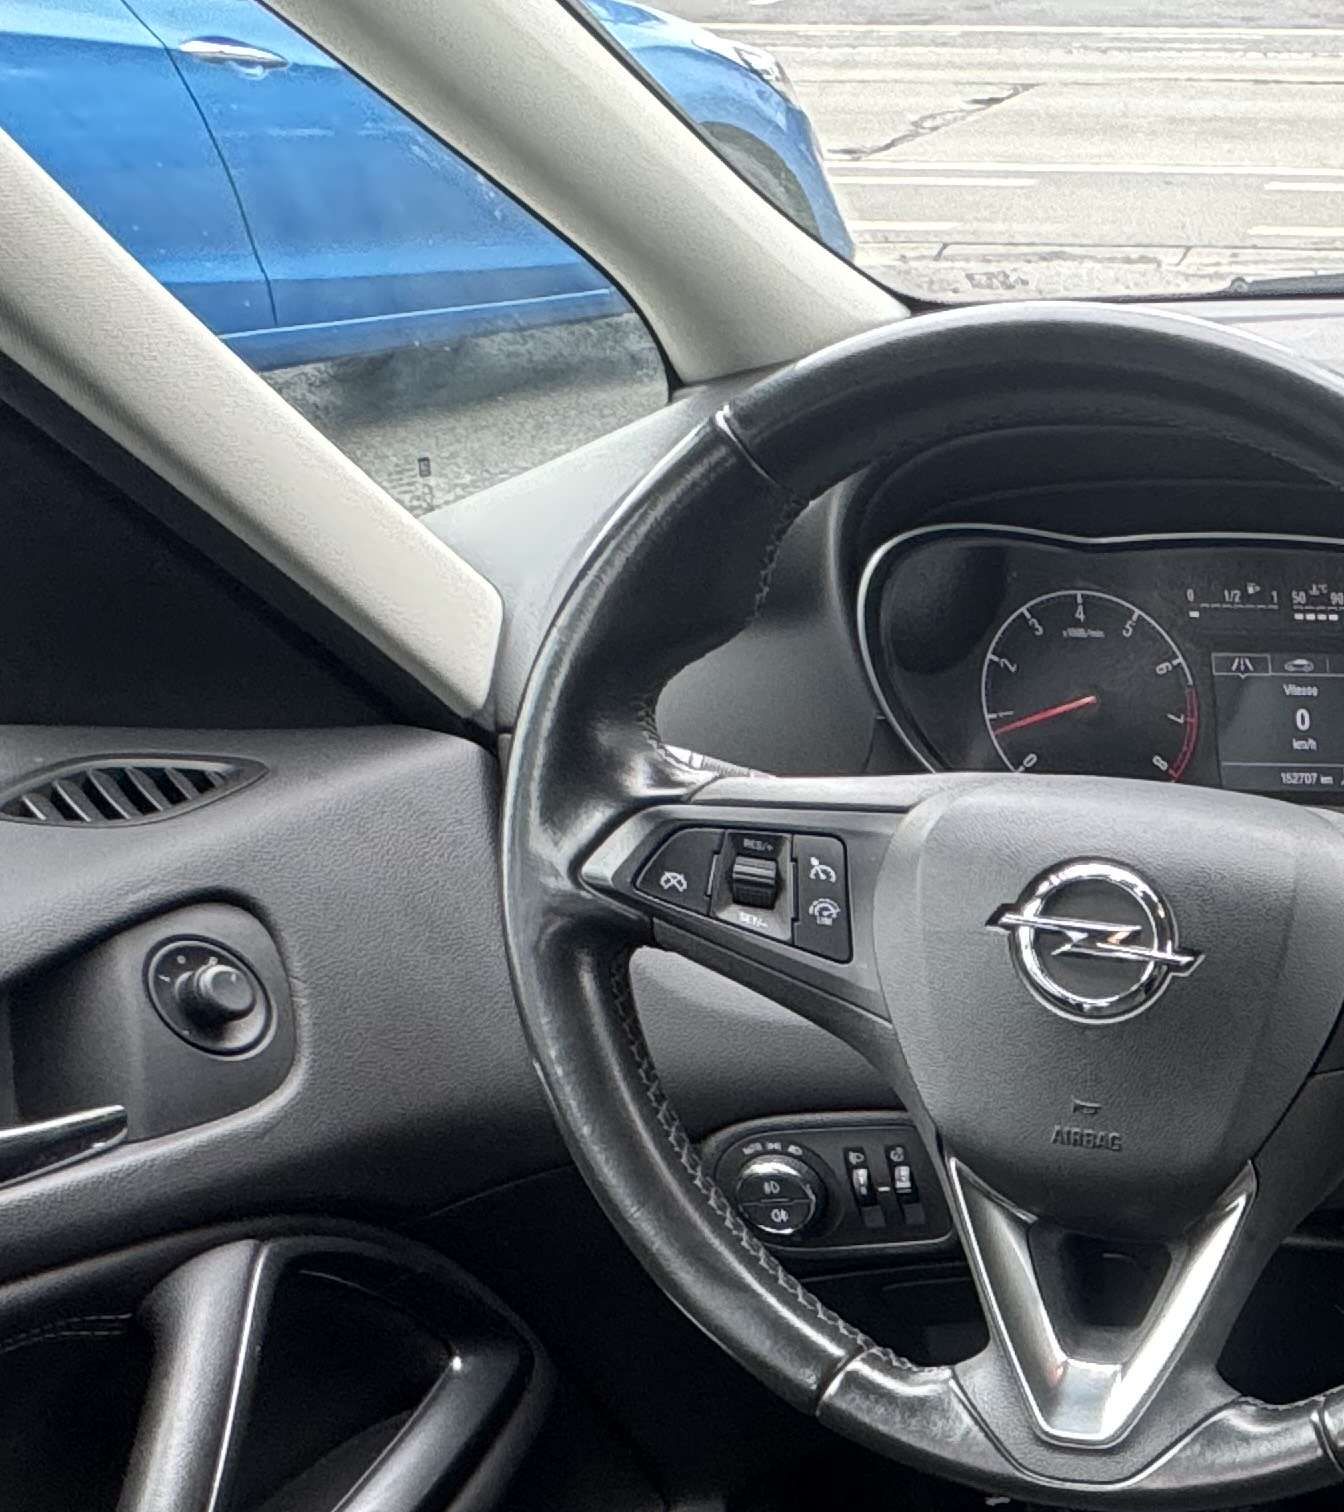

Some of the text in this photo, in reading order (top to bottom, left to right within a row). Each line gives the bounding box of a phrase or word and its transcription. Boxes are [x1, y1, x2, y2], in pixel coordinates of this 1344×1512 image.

[1075, 604, 1085, 622] 4
[1028, 618, 1044, 636] 3
[1122, 620, 1135, 637] 5
[1000, 657, 1017, 673] 2
[1155, 661, 1173, 675] 6
[1166, 712, 1184, 724] 7
[1295, 708, 1311, 731] 0
[1292, 737, 1317, 750] km/h
[1023, 752, 1037, 768] 0
[1152, 755, 1168, 771] 8
[1280, 772, 1318, 785] 152707
[1050, 1125, 1121, 1151] AIRBAG
